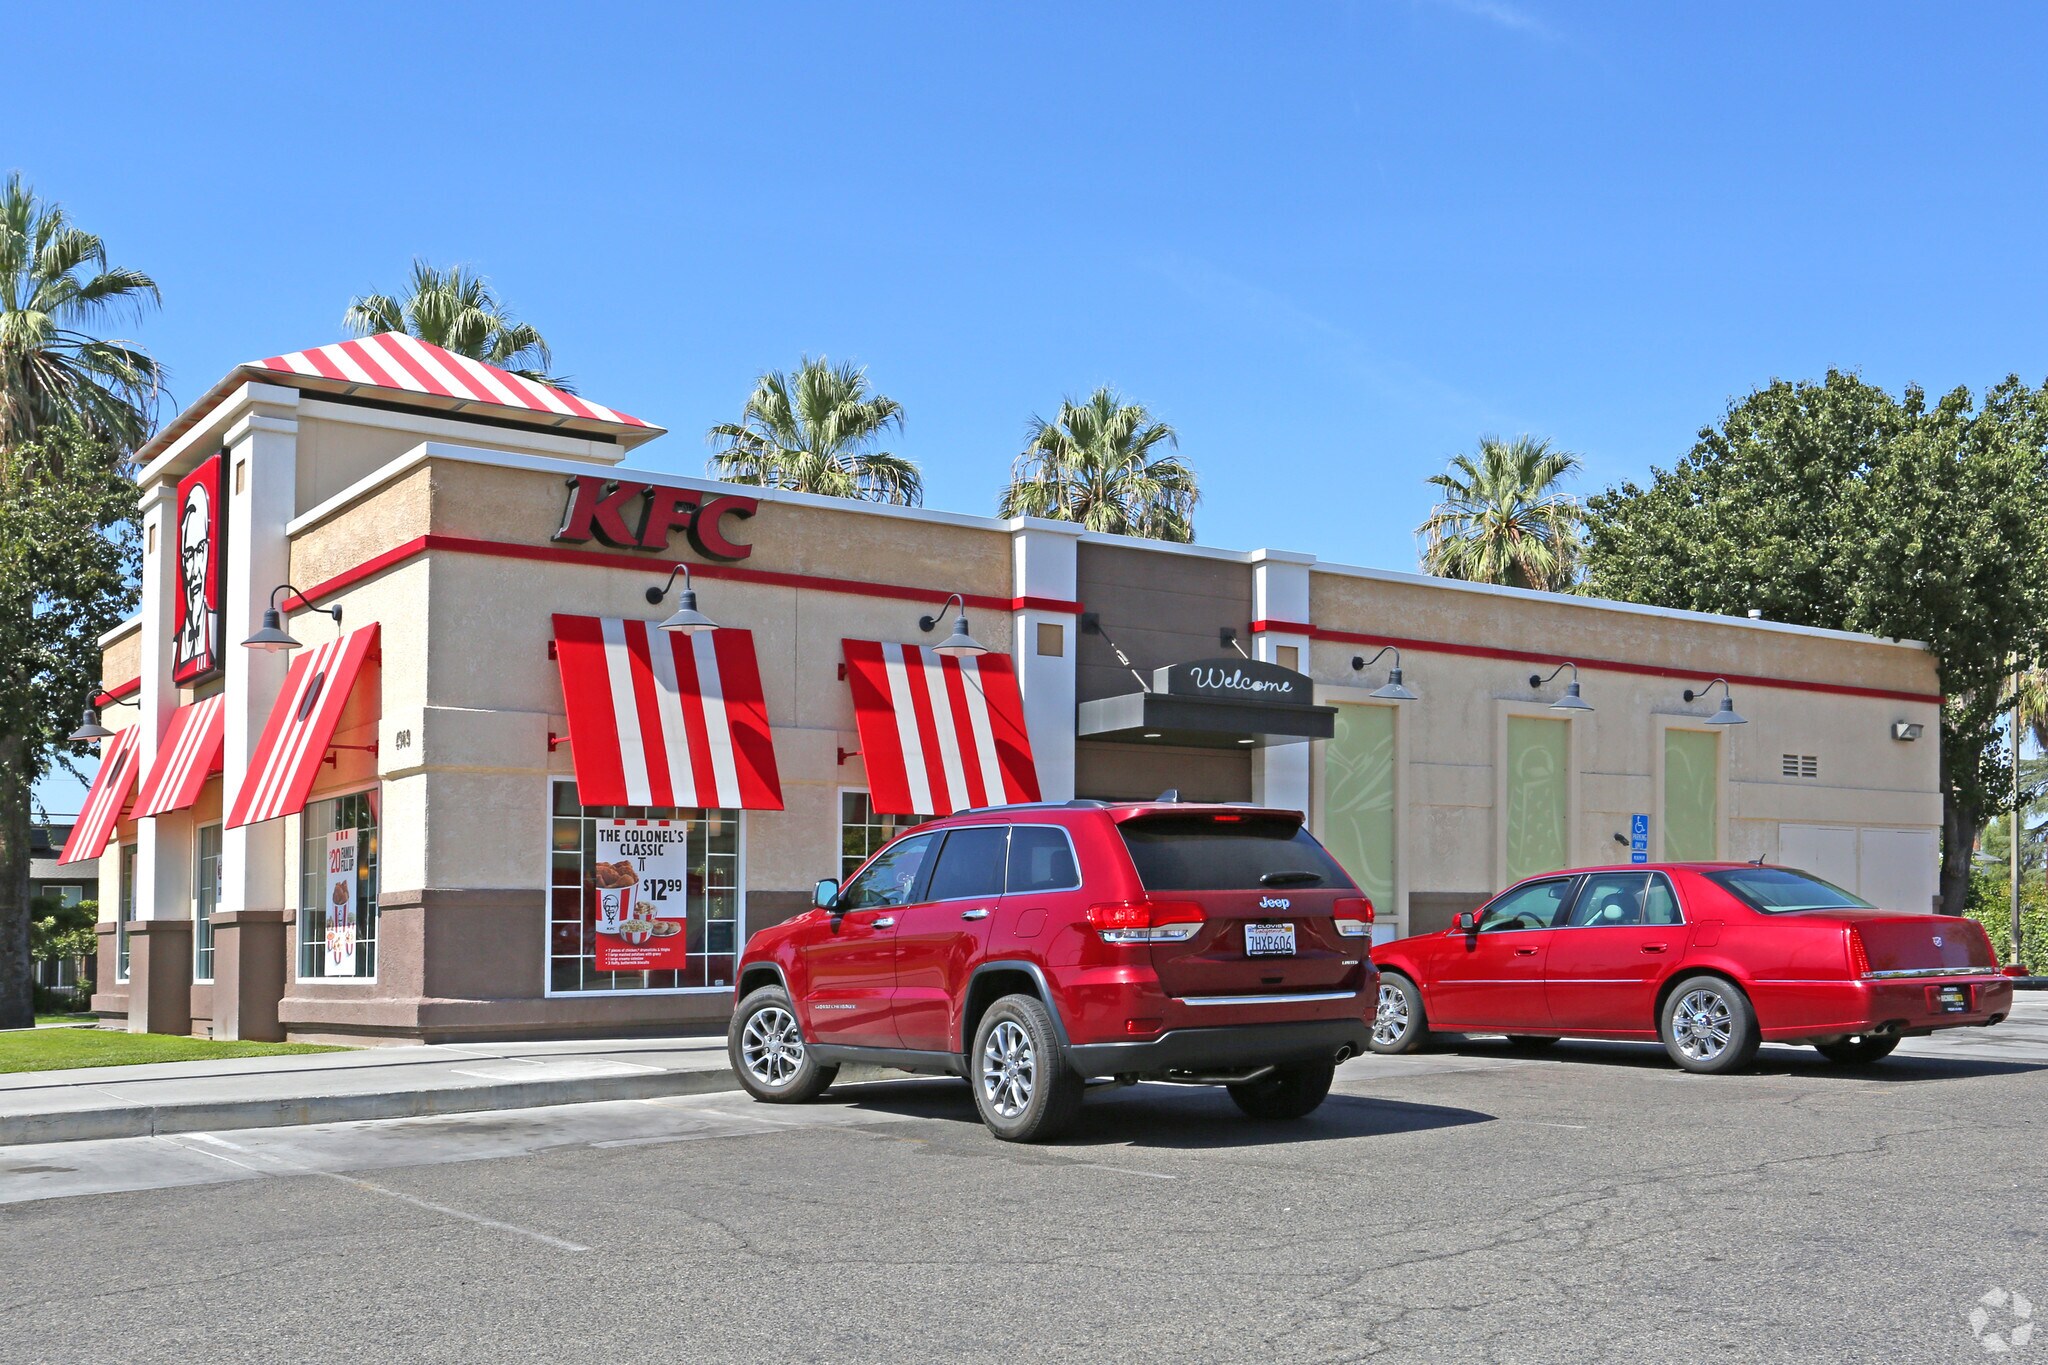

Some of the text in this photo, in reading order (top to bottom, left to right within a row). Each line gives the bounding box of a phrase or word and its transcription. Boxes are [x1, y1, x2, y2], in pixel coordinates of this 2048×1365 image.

[554, 475, 758, 561] KFC
[1190, 667, 1293, 693] Welcome
[599, 829, 684, 843] THE COLONEL'S
[340, 846, 355, 859] FAMILY
[620, 843, 664, 856] CLASSIC
[329, 848, 341, 873] $20
[340, 858, 355, 872] FILL UP
[1259, 896, 1291, 910] Jeep
[1249, 936, 1292, 950] 7HXP606
